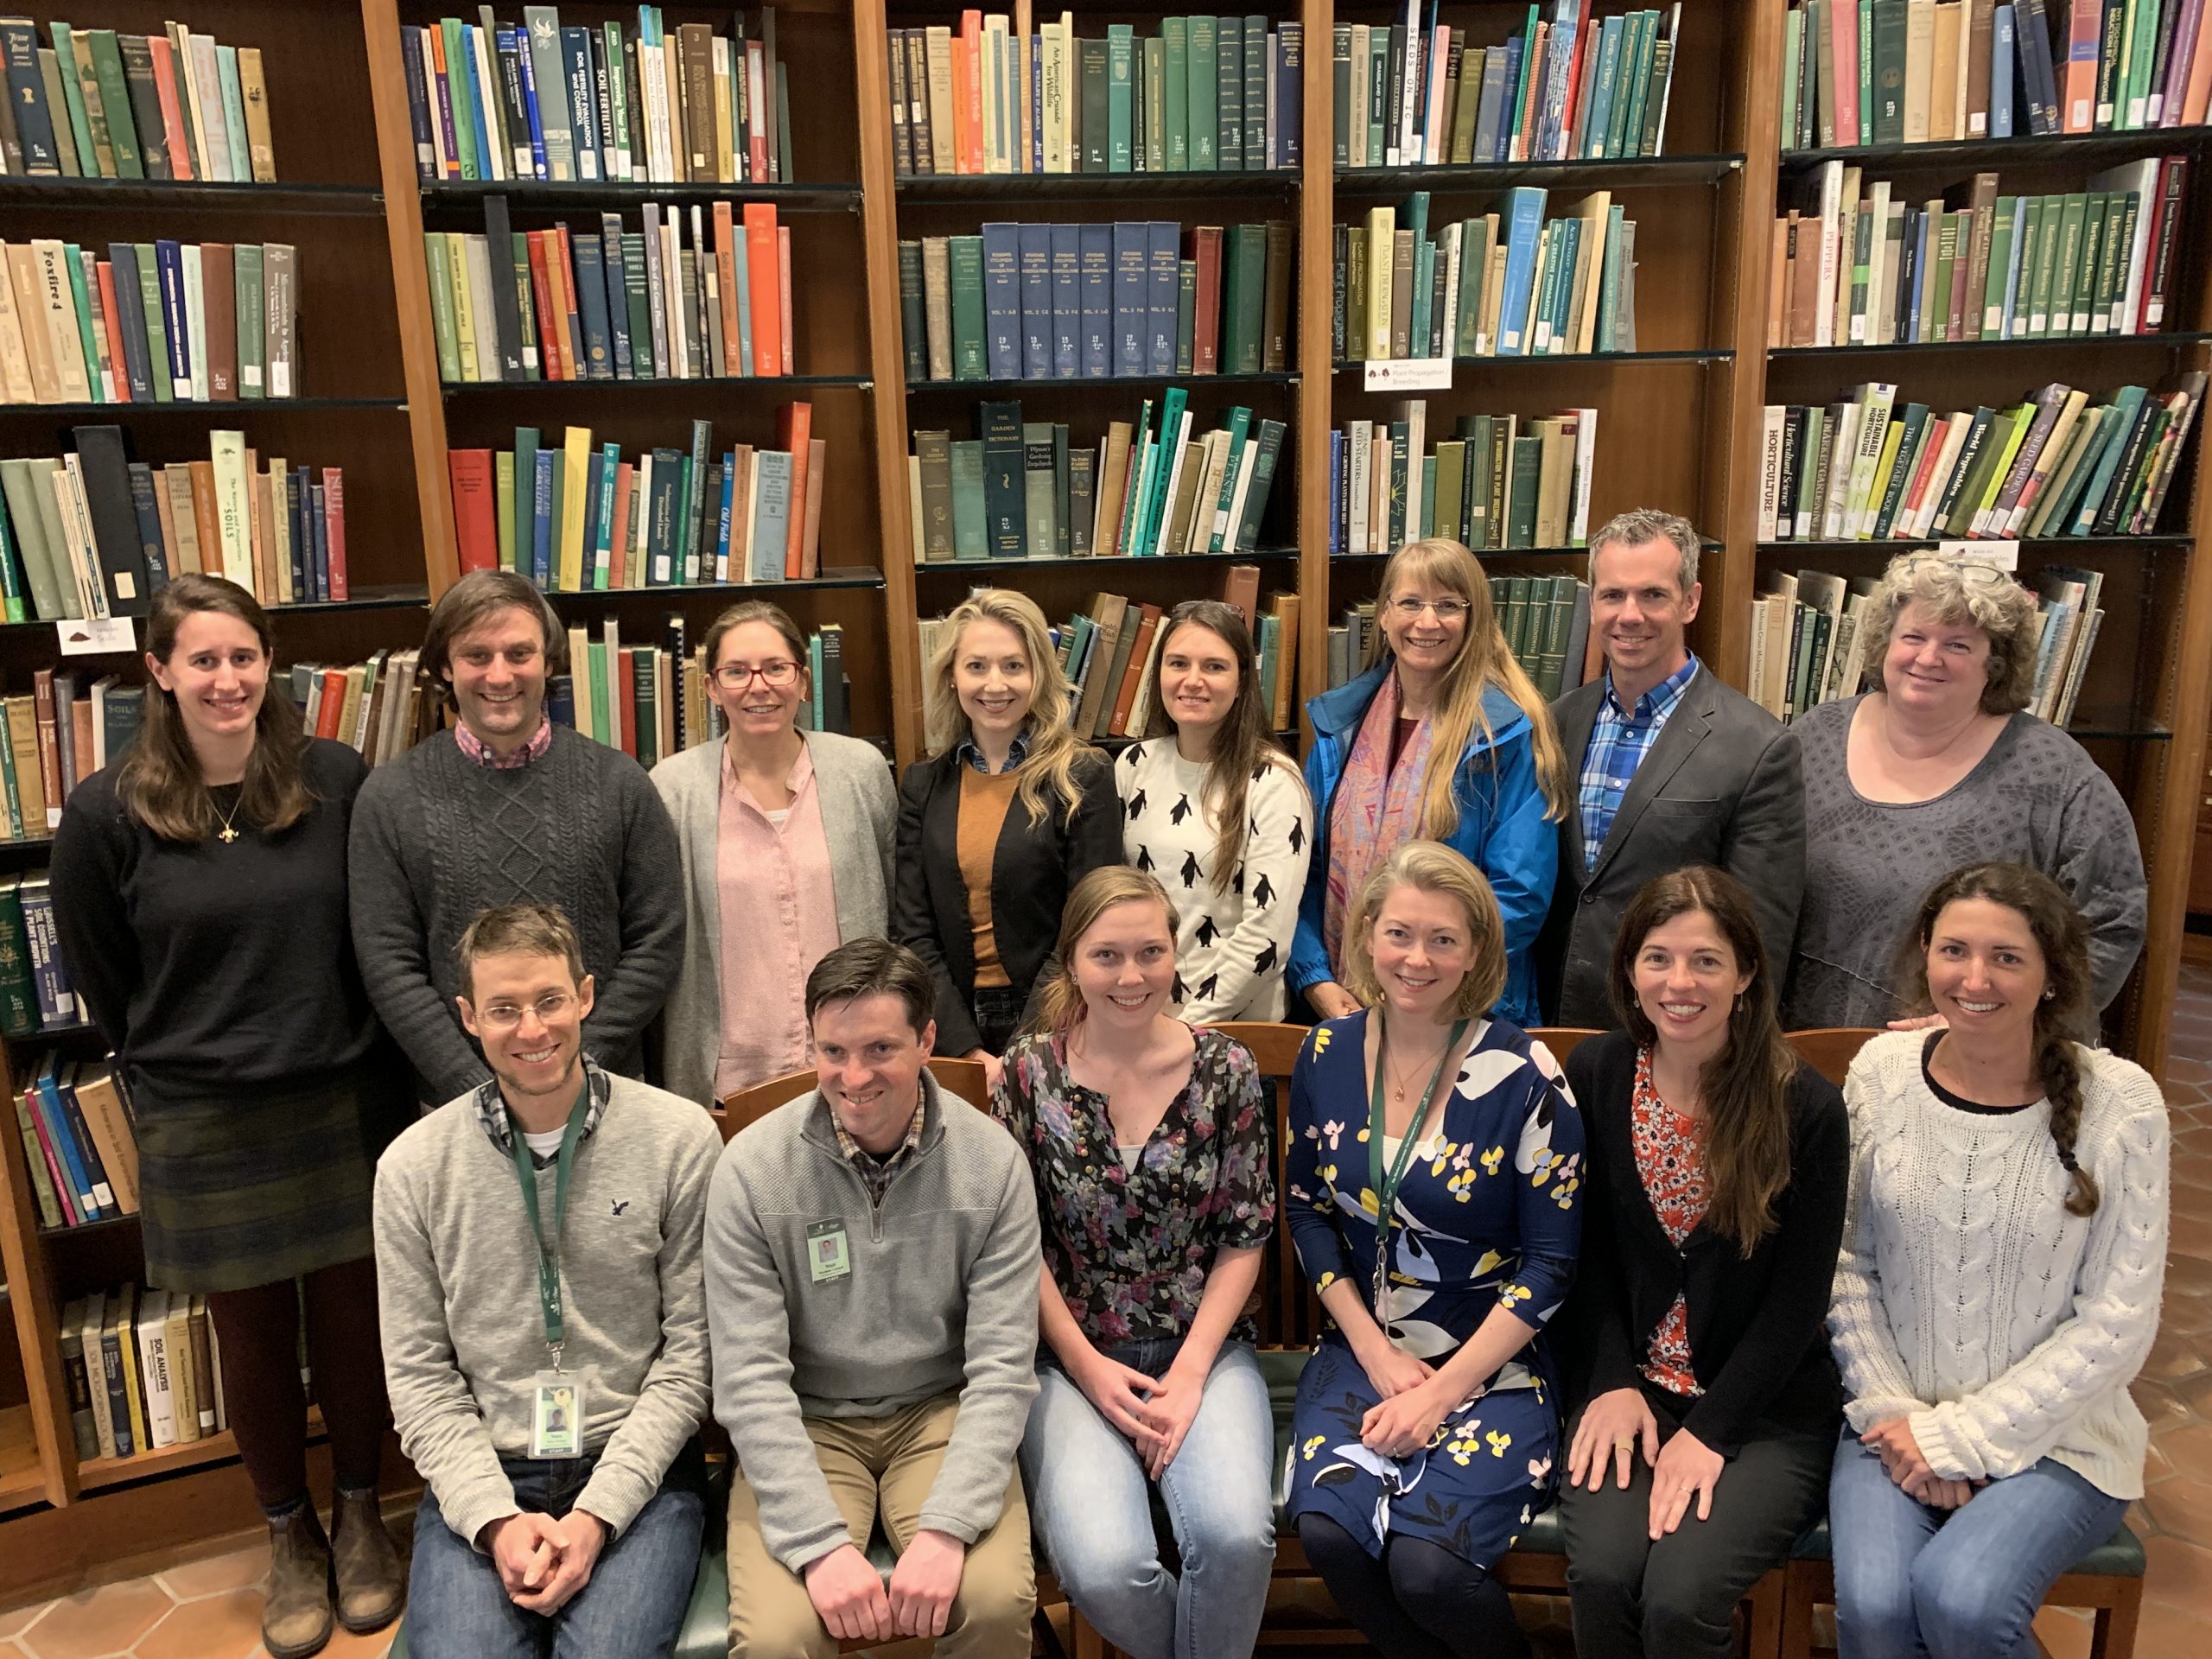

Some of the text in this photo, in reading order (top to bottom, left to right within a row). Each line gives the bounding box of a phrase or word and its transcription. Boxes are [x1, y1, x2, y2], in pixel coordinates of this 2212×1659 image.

[694, 33, 699, 41] 3
[1626, 35, 1634, 68] propagation
[2107, 7, 2116, 48] INDUCTION
[1054, 47, 1061, 58] An
[1406, 27, 1417, 93] SEEDS ON
[2105, 49, 2113, 57] BY
[574, 91, 583, 126] CONTROL
[576, 52, 592, 147] SOIL FERTILITY EVALUATION
[597, 69, 612, 138] SOIL FERTILITY
[613, 66, 623, 106] Improving
[619, 128, 627, 143] Soil
[1984, 206, 1994, 234] Handbook
[1823, 231, 1835, 281] PEPPERS
[2018, 225, 2034, 298] Horticultural Reviews
[2039, 225, 2056, 296] Horticultural Reviews
[2061, 225, 2077, 295] Horticultural Reviews
[2082, 222, 2100, 292] Horticultural Reviews
[2101, 215, 2121, 298] Horticultural Reviews
[2117, 209, 2136, 292] Horticultural Reviews
[43, 251, 60, 299] Foxfire
[1543, 243, 1558, 320] CREATIVE PROPAGATION
[1333, 262, 1346, 350] Plant Propagation
[1381, 273, 1390, 326] PROPAGATION
[1409, 369, 1444, 378] Propagation
[1859, 407, 1878, 457] HORTICULTURE
[1868, 408, 1887, 458] SUSTAINABLE
[2027, 433, 2046, 457] SEED
[2040, 423, 2048, 432] The
[1161, 437, 1175, 472] gardening
[1354, 426, 1363, 480] SEED-STARTERS
[1495, 440, 1503, 472] INTRODUCTION
[1764, 429, 1779, 512] HORTICULTURE
[1780, 423, 1796, 507] Horticultural Science
[1811, 424, 1833, 527] MARKET GARDENING
[1882, 426, 1916, 512] THE VEGETABLE BOOK
[1949, 423, 1987, 497] World Vegetables
[2009, 458, 2032, 496] GARDEN
[2164, 450, 2179, 474] Fruits
[535, 464, 544, 516] AGRICULTURE
[1220, 454, 1235, 502] PLANTS
[1580, 483, 1588, 508] Breeding
[224, 509, 235, 538] SOILS
[719, 507, 730, 542] Old Fields
[1151, 499, 1163, 534] classroom
[1754, 649, 1763, 672] Making
[342, 703, 355, 742] FERTILITY
[25, 916, 37, 938] PLANT
[35, 908, 51, 964] SOIL CONDITIONS
[43, 906, 58, 946] RUSSELL'S
[30, 940, 42, 969] GROWTH
[113, 1141, 122, 1153] Soil
[153, 1338, 168, 1392] SOIL ANALYSIS
